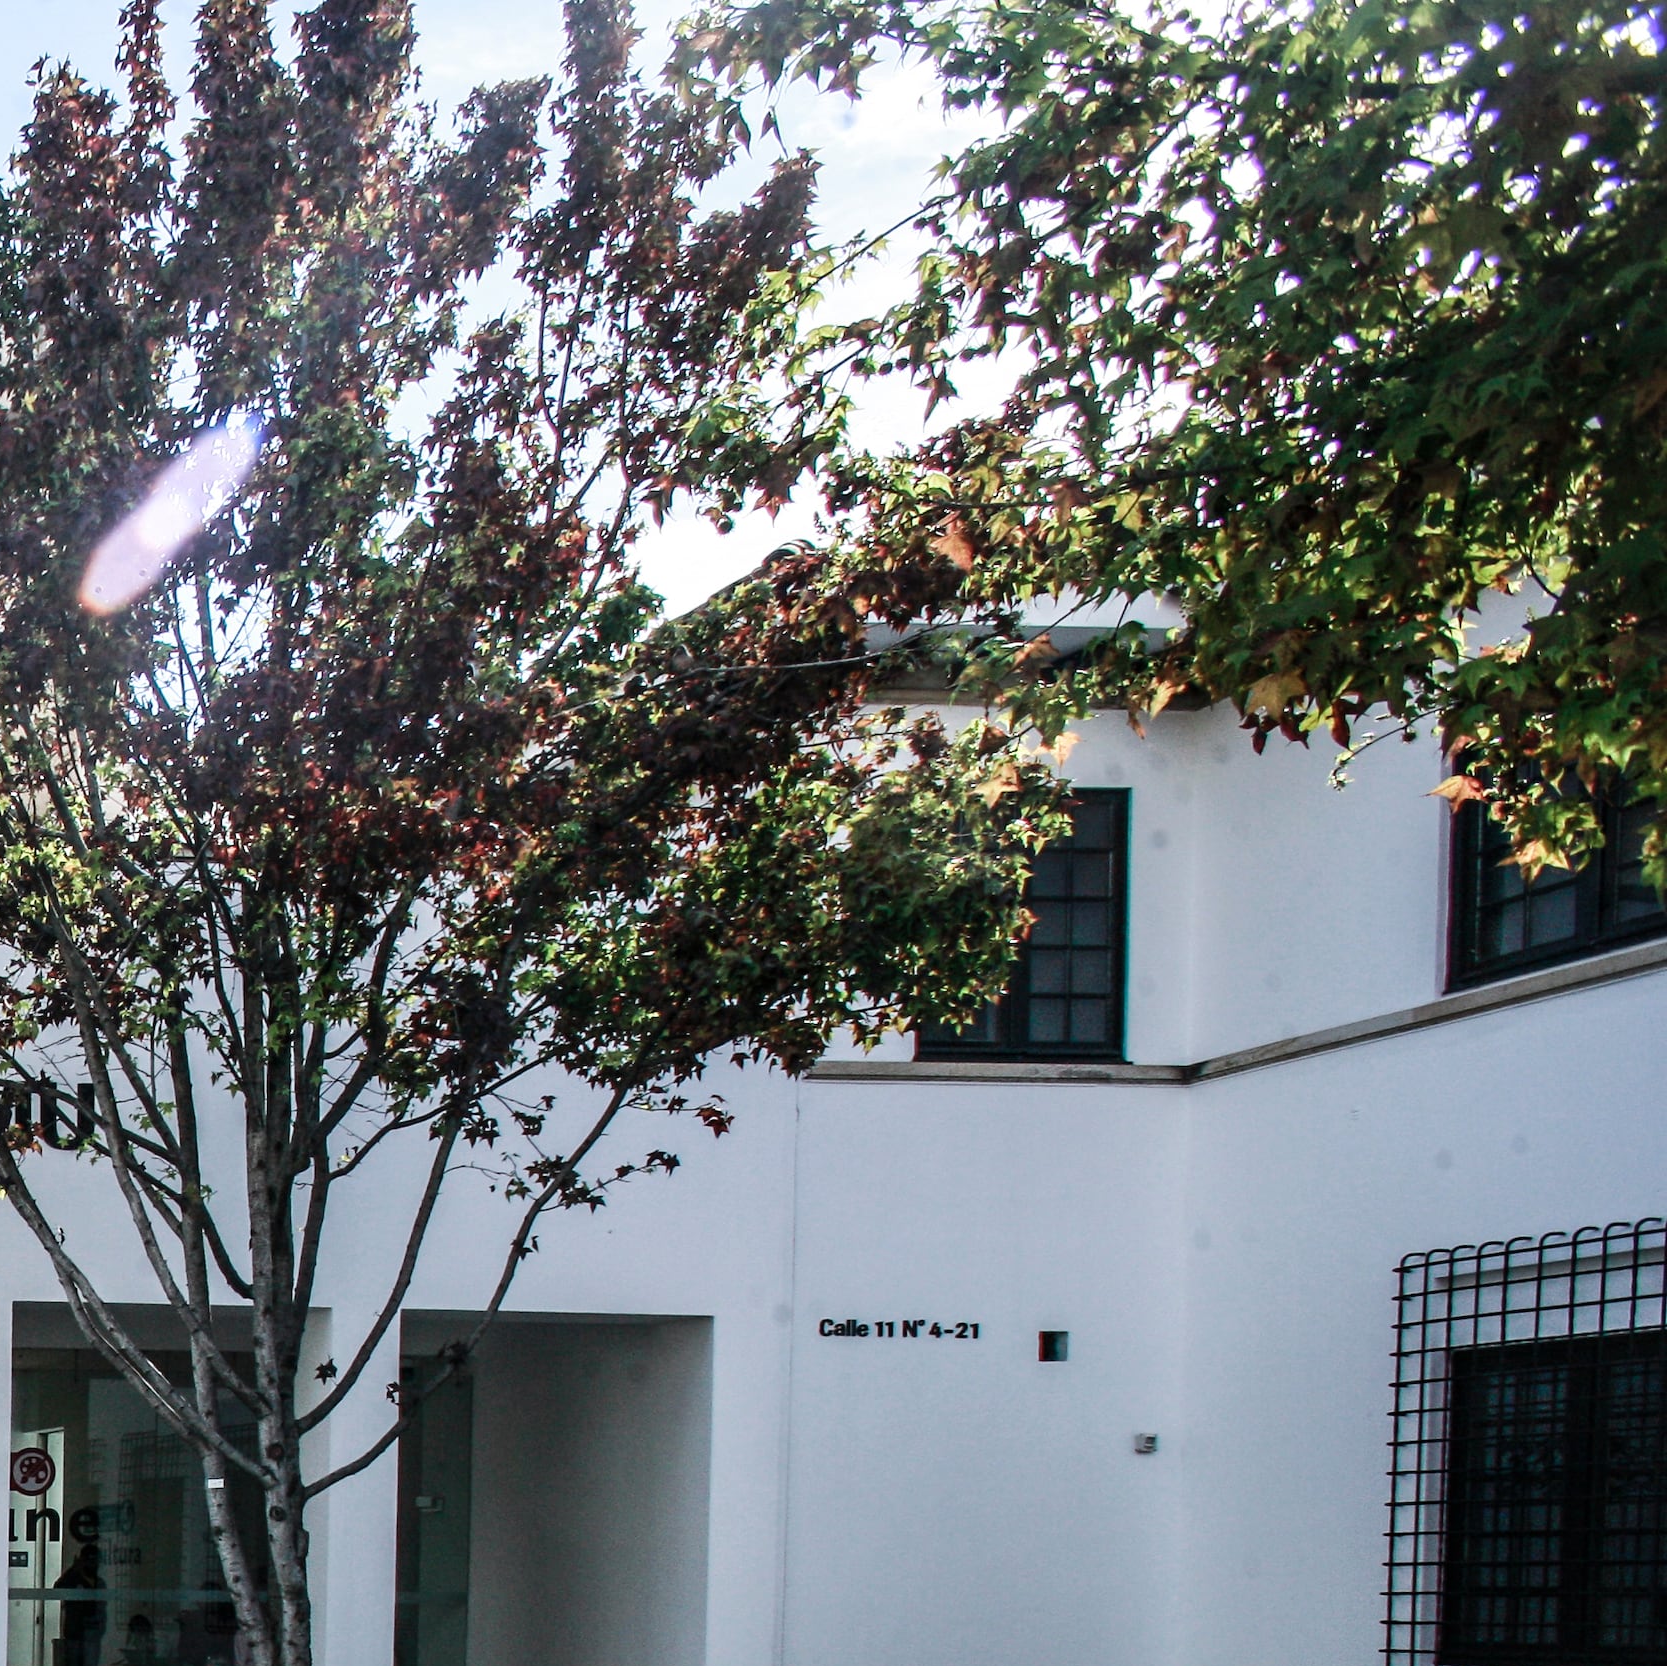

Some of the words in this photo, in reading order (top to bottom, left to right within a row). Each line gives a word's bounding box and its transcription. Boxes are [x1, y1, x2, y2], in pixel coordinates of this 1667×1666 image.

[818, 1318, 869, 1338] Calle
[875, 1321, 894, 1338] 11
[929, 1322, 980, 1339] 4-21
